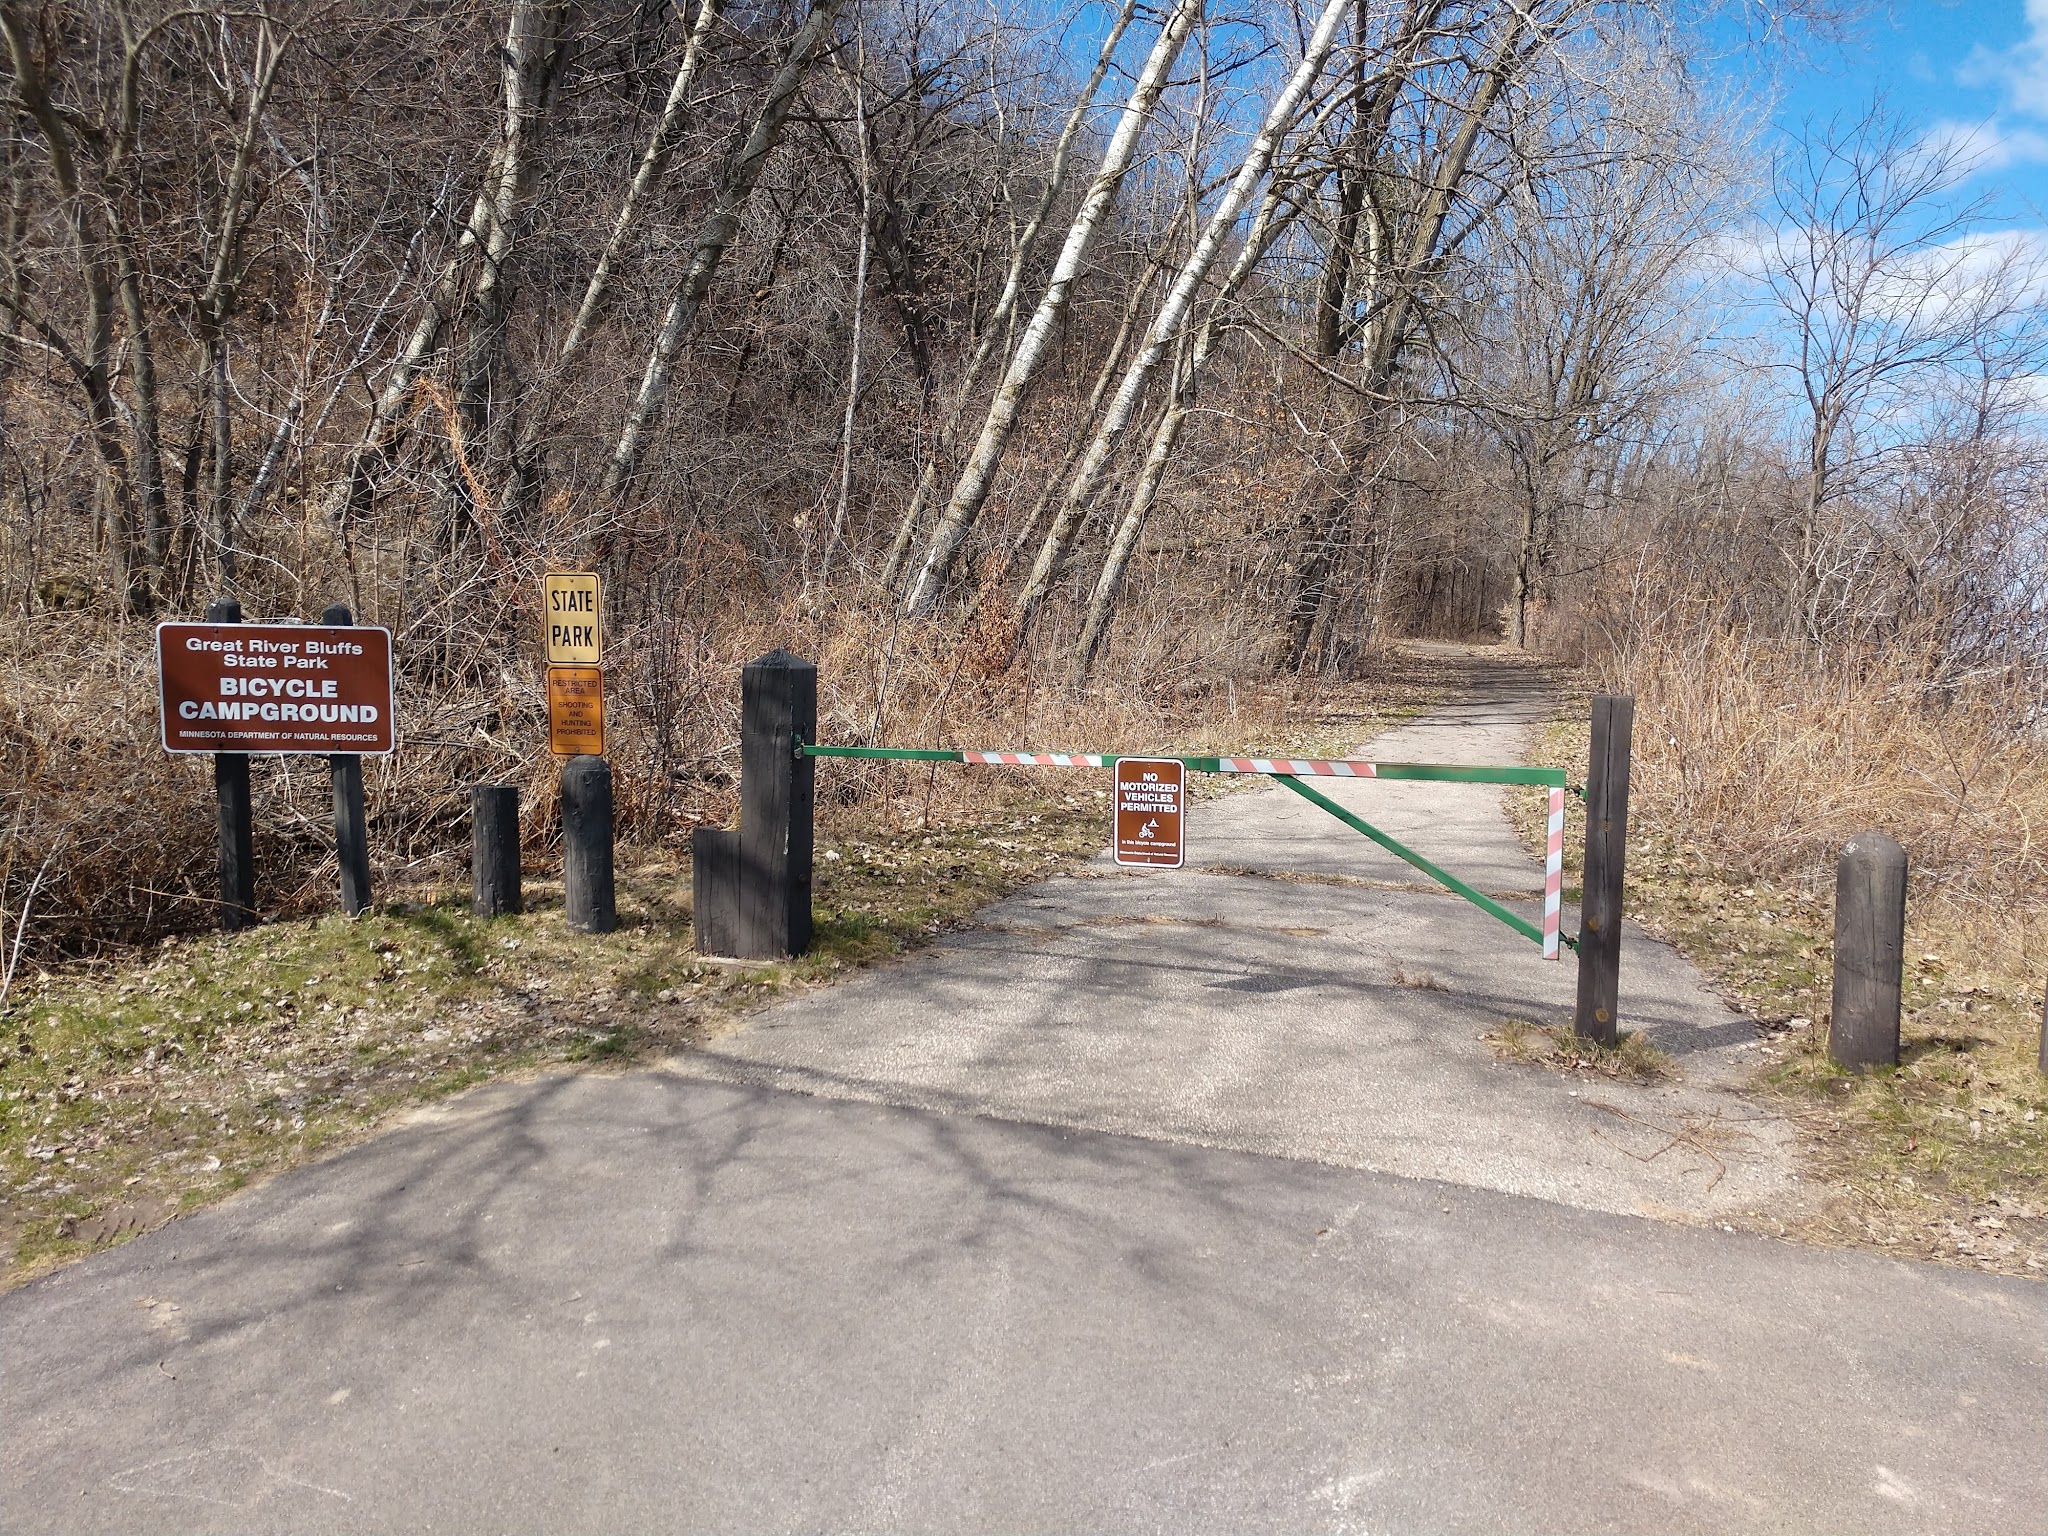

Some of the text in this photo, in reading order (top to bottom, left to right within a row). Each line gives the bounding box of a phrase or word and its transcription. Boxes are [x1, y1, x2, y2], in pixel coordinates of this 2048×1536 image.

[552, 590, 592, 612] STATE
[552, 625, 593, 647] PARK
[186, 638, 363, 655] Great River Bluffs
[224, 654, 328, 669] State Park
[220, 678, 338, 698] BICYCLE
[552, 680, 597, 688] RESTRICTED
[179, 701, 378, 723] CAMPGROUND
[561, 720, 591, 728] HUNTING
[179, 731, 226, 739] MINNESOTA
[228, 731, 279, 740] DEPARTMENT
[557, 728, 596, 736] PROHIBITED
[1143, 773, 1158, 781] NO
[1120, 782, 1178, 792] MOTORIZED
[1125, 792, 1173, 802] VEHICLES
[1121, 803, 1177, 813] PERMITTED
